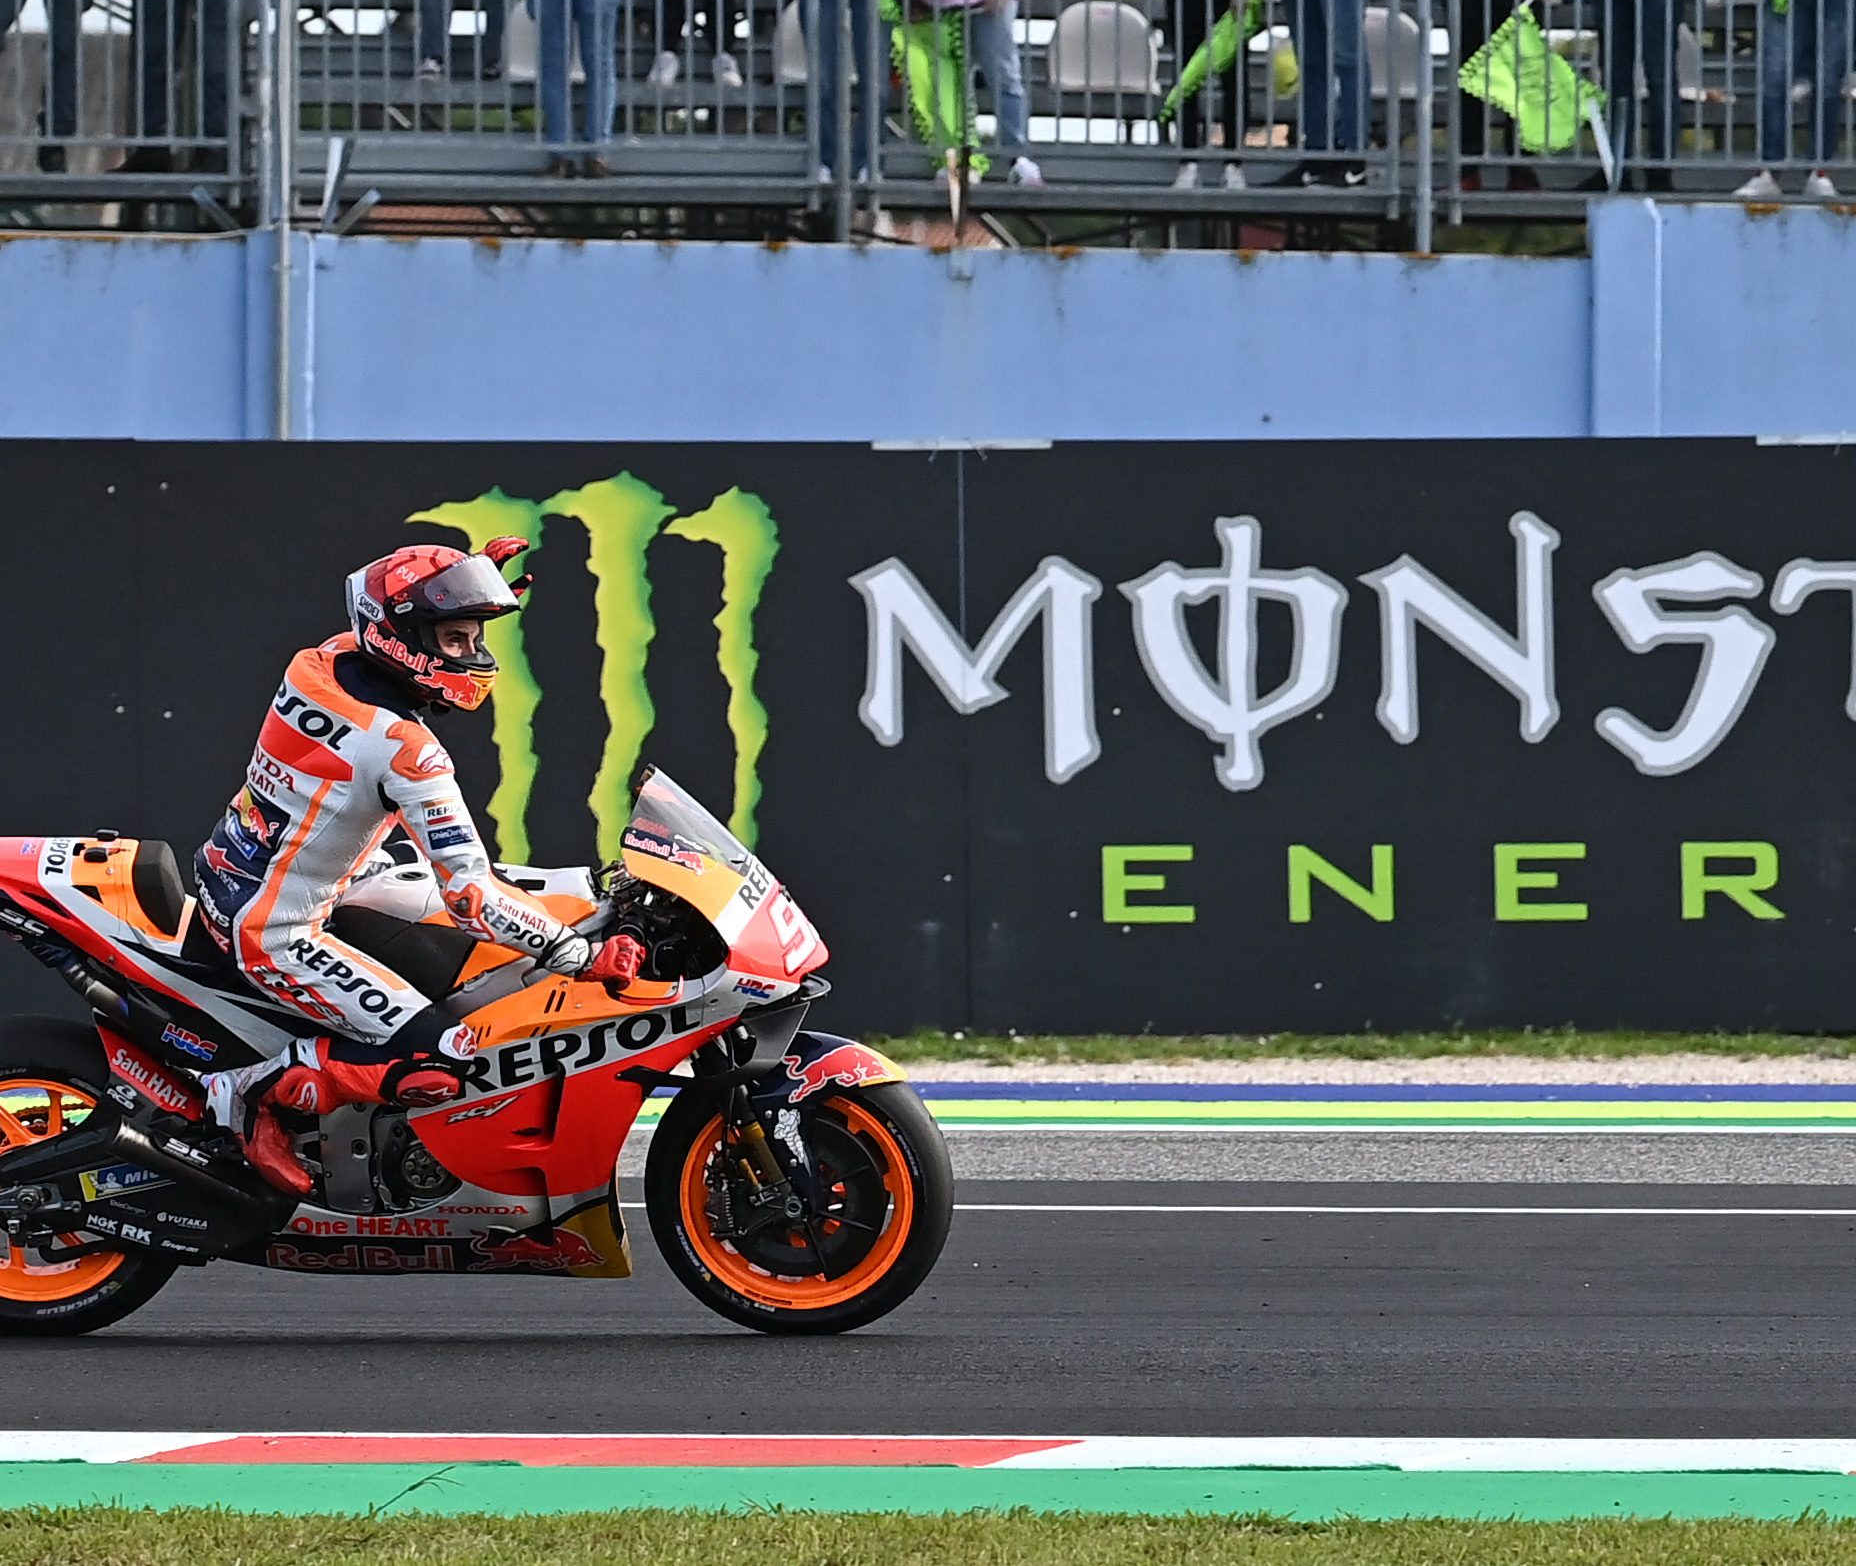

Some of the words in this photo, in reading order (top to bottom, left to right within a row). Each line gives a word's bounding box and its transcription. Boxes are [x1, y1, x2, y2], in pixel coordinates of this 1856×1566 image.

[357, 595, 381, 620] SHOEI
[364, 621, 396, 653] Red
[394, 643, 429, 673] Bull
[276, 679, 353, 752] PSOL
[255, 747, 296, 794] NDA
[44, 838, 70, 876] EPSOL
[625, 833, 648, 850] Red
[646, 839, 671, 857] Bull
[738, 863, 771, 911] REP
[481, 903, 546, 949] REPSO
[496, 897, 519, 918] Satu
[765, 892, 819, 977] 9
[287, 937, 404, 1028] REPSOL
[733, 977, 777, 1000] HRC
[161, 1022, 218, 1062] HRC
[455, 1005, 701, 1101] REPSOL
[111, 1047, 149, 1084] Satu
[147, 1072, 188, 1110] HATI.
[86, 1213, 119, 1230] NGK
[122, 1223, 153, 1242] RK
[167, 1214, 208, 1227] YUTAKA
[291, 1216, 348, 1236] One
[355, 1216, 452, 1237] HEART.
[437, 1204, 530, 1215] HONDA
[266, 1242, 360, 1270] Red
[362, 1245, 455, 1271] Bull
